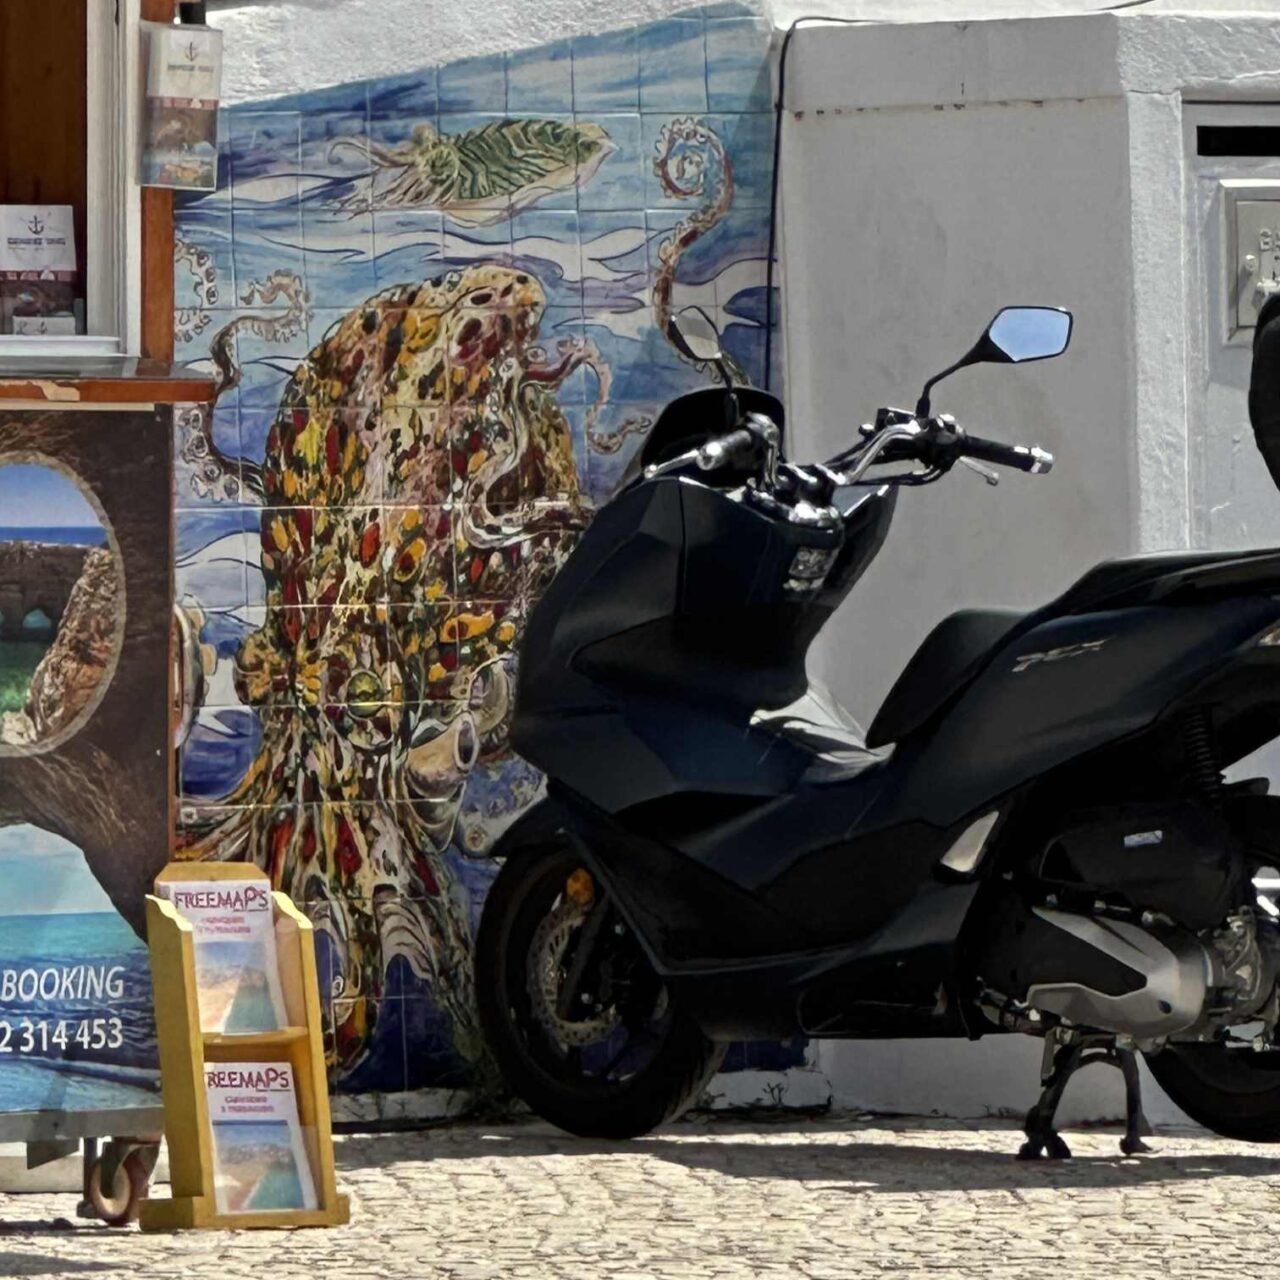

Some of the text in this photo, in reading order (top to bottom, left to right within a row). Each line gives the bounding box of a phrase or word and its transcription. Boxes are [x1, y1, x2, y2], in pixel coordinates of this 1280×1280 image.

[1, 966, 124, 1001] BOOKING
[20, 1019, 69, 1052] 314
[75, 1017, 123, 1050] 453
[206, 1067, 289, 1089] REEMAPS
